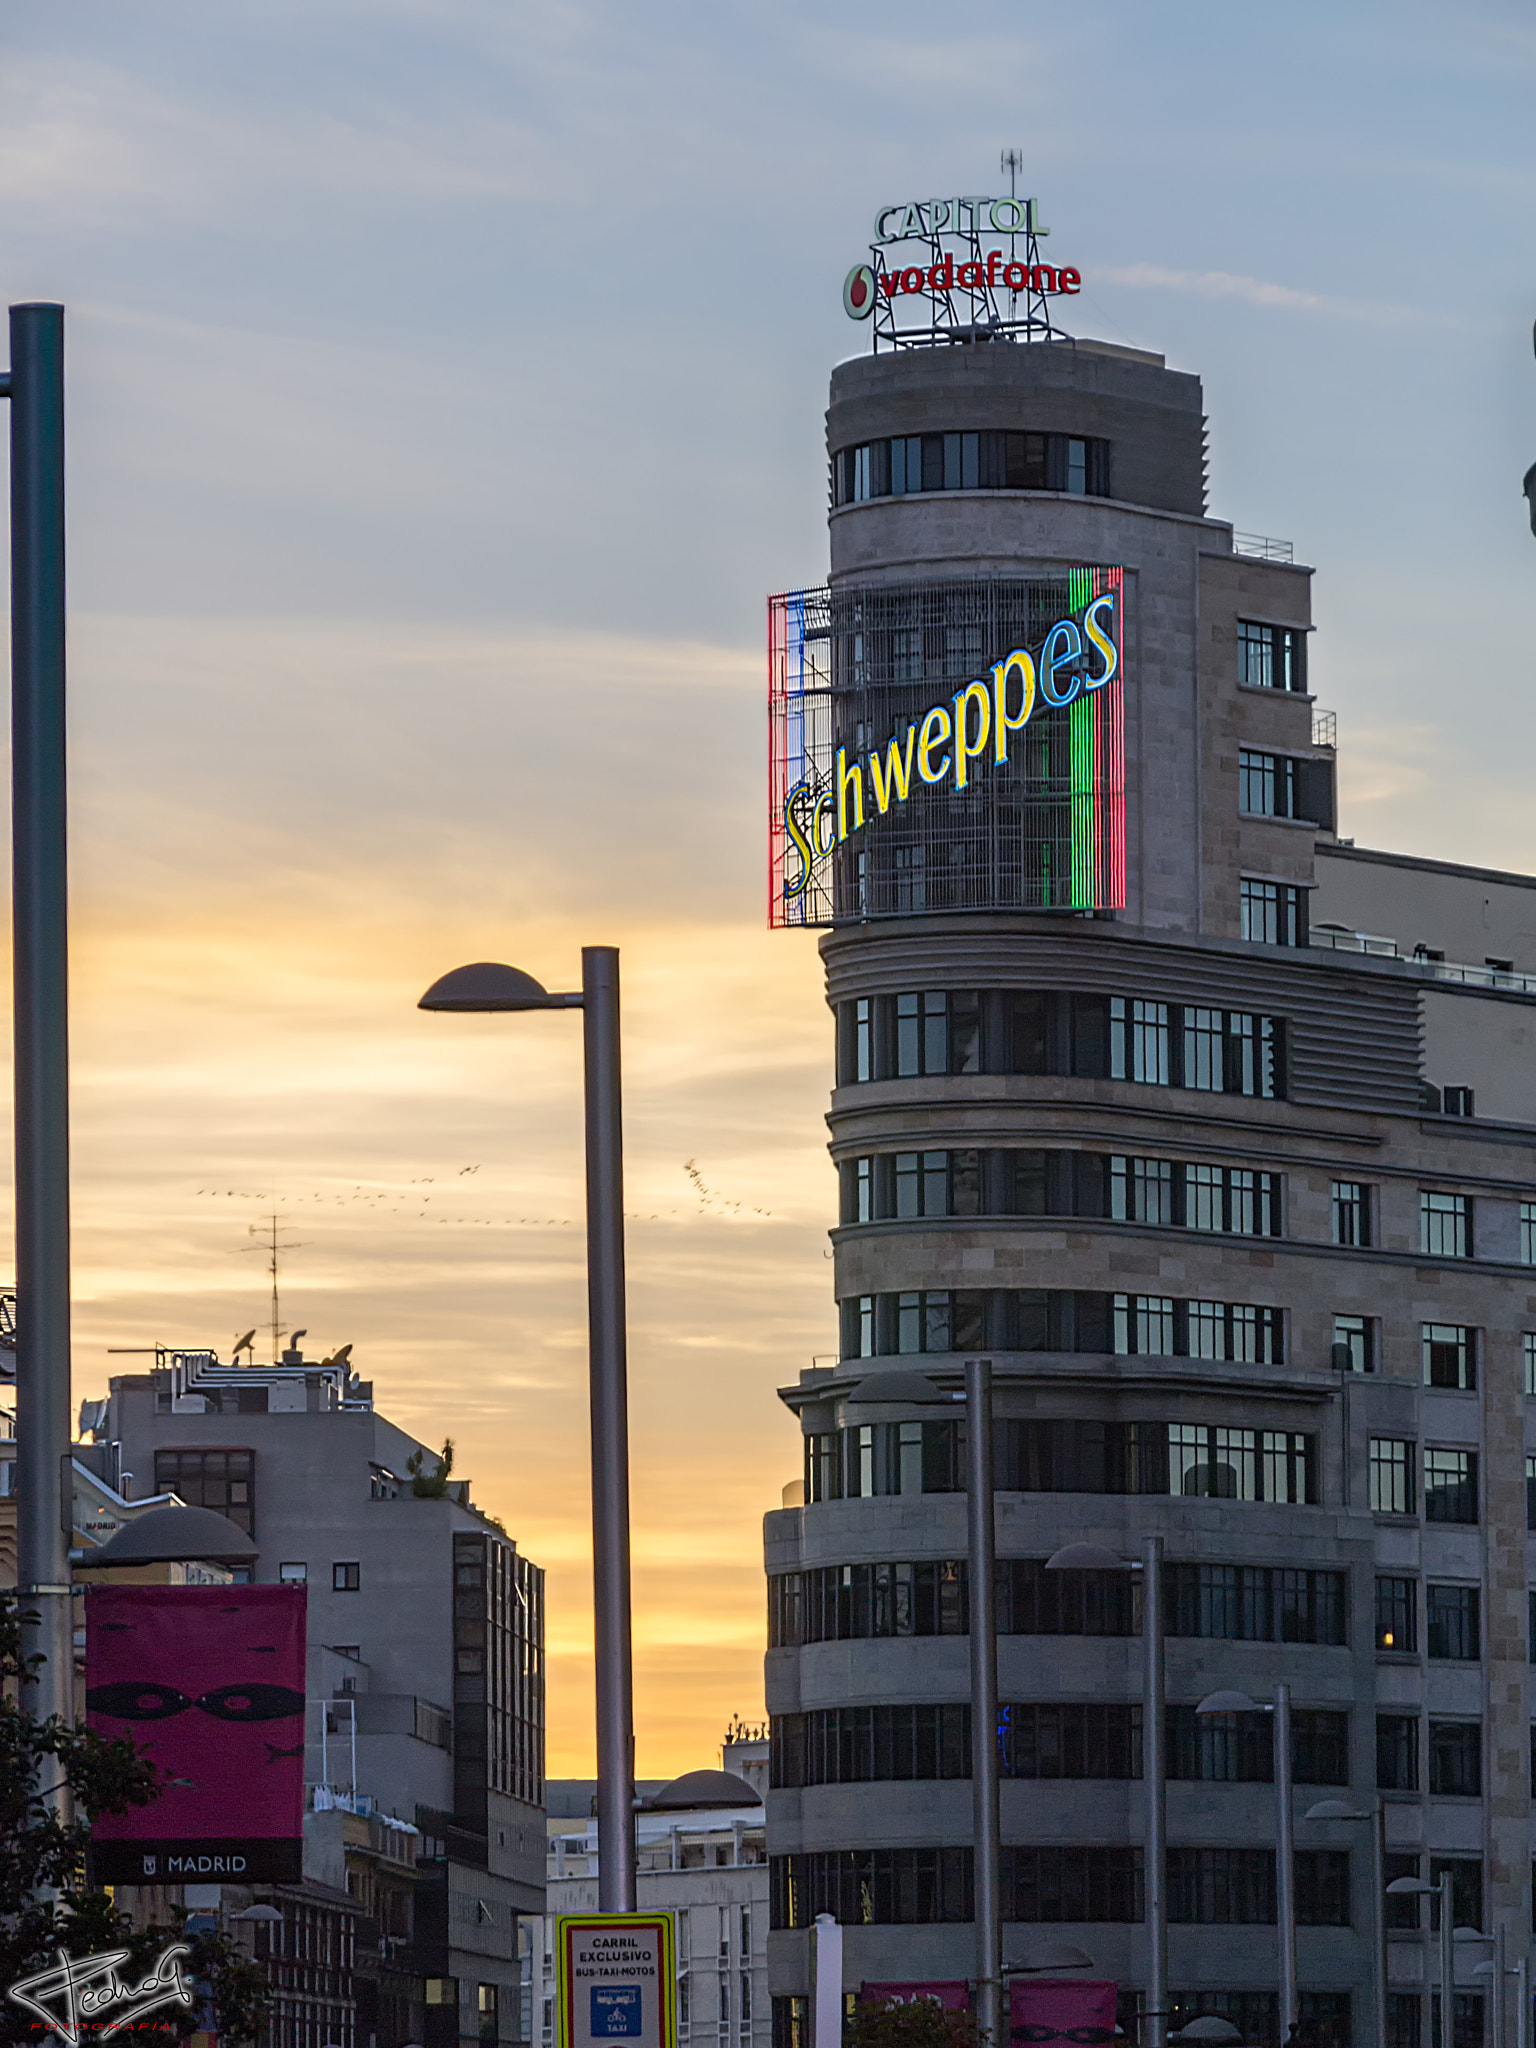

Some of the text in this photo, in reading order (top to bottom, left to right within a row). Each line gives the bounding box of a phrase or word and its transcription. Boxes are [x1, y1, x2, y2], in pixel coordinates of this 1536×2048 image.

[874, 196, 1050, 243] CAPITOL
[879, 250, 1081, 294] vodafone
[784, 593, 1118, 899] Schweppes
[86, 1522, 116, 1530] MADRID
[168, 1856, 246, 1872] MADRID
[592, 1938, 638, 1948] CARRIL
[580, 1951, 651, 1962] EXCLUSIVO
[607, 2024, 627, 2032] TAXI
